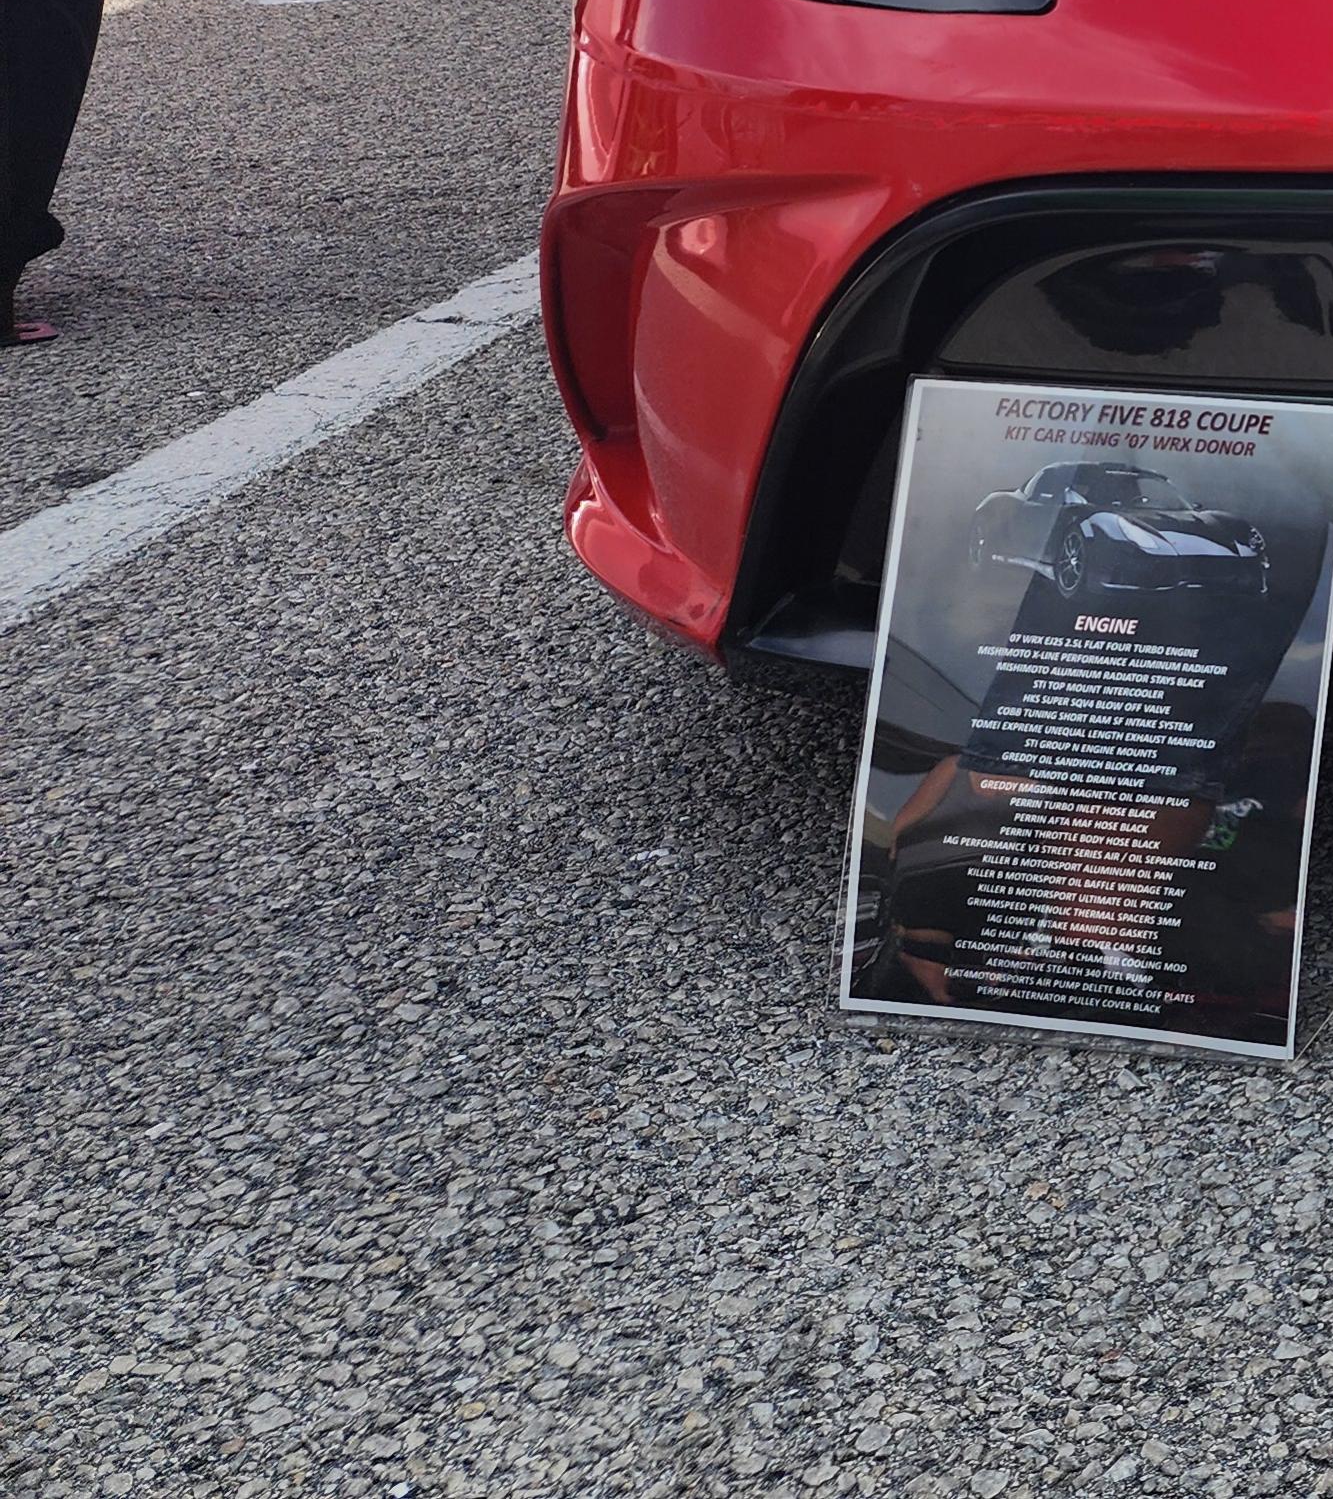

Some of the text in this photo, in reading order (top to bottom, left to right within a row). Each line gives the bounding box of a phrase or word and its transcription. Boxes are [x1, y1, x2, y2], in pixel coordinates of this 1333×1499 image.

[995, 397, 1273, 435] FACTORY FIVE 818 COUPE
[1003, 424, 1256, 456] KIT CAR USING '07 WRX DONOR
[1074, 614, 1138, 634] ENGINE
[1008, 632, 1022, 643] 07
[1021, 634, 1045, 644] WRX
[1083, 639, 1106, 650] FLAT
[1104, 641, 1132, 652] FOUR
[1133, 643, 1165, 655] TURBO
[1164, 646, 1199, 658] ENGINE
[976, 645, 1228, 675] MISHIMOTO X-LINE PERFORMANCE ALUMINUM RADIATOR
[994, 661, 1205, 688] MISHIMOTO ALUMINUM RADIATOR STAYS BLACK
[1032, 679, 1164, 699] STI TOP MOUNT INTERCOOLER
[1021, 693, 1041, 703] HKS
[1040, 694, 1070, 706] SUPER
[1094, 699, 1124, 711] BLOW
[1123, 701, 1142, 712] OFF
[1143, 703, 1171, 715] VALVE
[996, 705, 1193, 732] COBB TUNING SHORT RAM SF INTAKE SYSTEM
[970, 718, 1001, 730] TOMEI
[1043, 725, 1085, 737] UNEQUAL
[1087, 729, 1124, 740] LENGTH
[1124, 731, 1167, 744] EXHAUST
[1166, 735, 1216, 749] MANIFOLD
[1023, 737, 1157, 759] STI GROUP N ENGINE MOUNTS
[1001, 750, 1177, 776] GREDDY OIL SANDWICH BLOCK ADAPTER
[1028, 768, 1145, 788] FUMOTO OIL DRAIN VALVE
[979, 778, 1189, 808] GREDDY MAGDRAIN MAGNETIC OIL DRAIN PLUG
[1008, 796, 1157, 819] PERRIN TURBO INLET HOSE BLACK
[1013, 812, 1047, 824] PERRIN
[1071, 817, 1093, 828] MAF
[1093, 819, 1119, 831] HOSE
[1118, 822, 1149, 833] BLACK
[998, 825, 1161, 850] PERRIN THROTTLE BODY HOSE BLACK
[981, 853, 1173, 881] KILLER B MOTORSPORT ALUMINUM OIL PAN
[966, 896, 1027, 911] GRIMMSPEED
[1027, 902, 1072, 916] PHENOLIC
[1073, 907, 1115, 921] THERMAL
[1116, 911, 1155, 924] SPACERS
[976, 985, 1161, 1014] PERRIN ALTERNATOR PULLEY COVER BLACK
